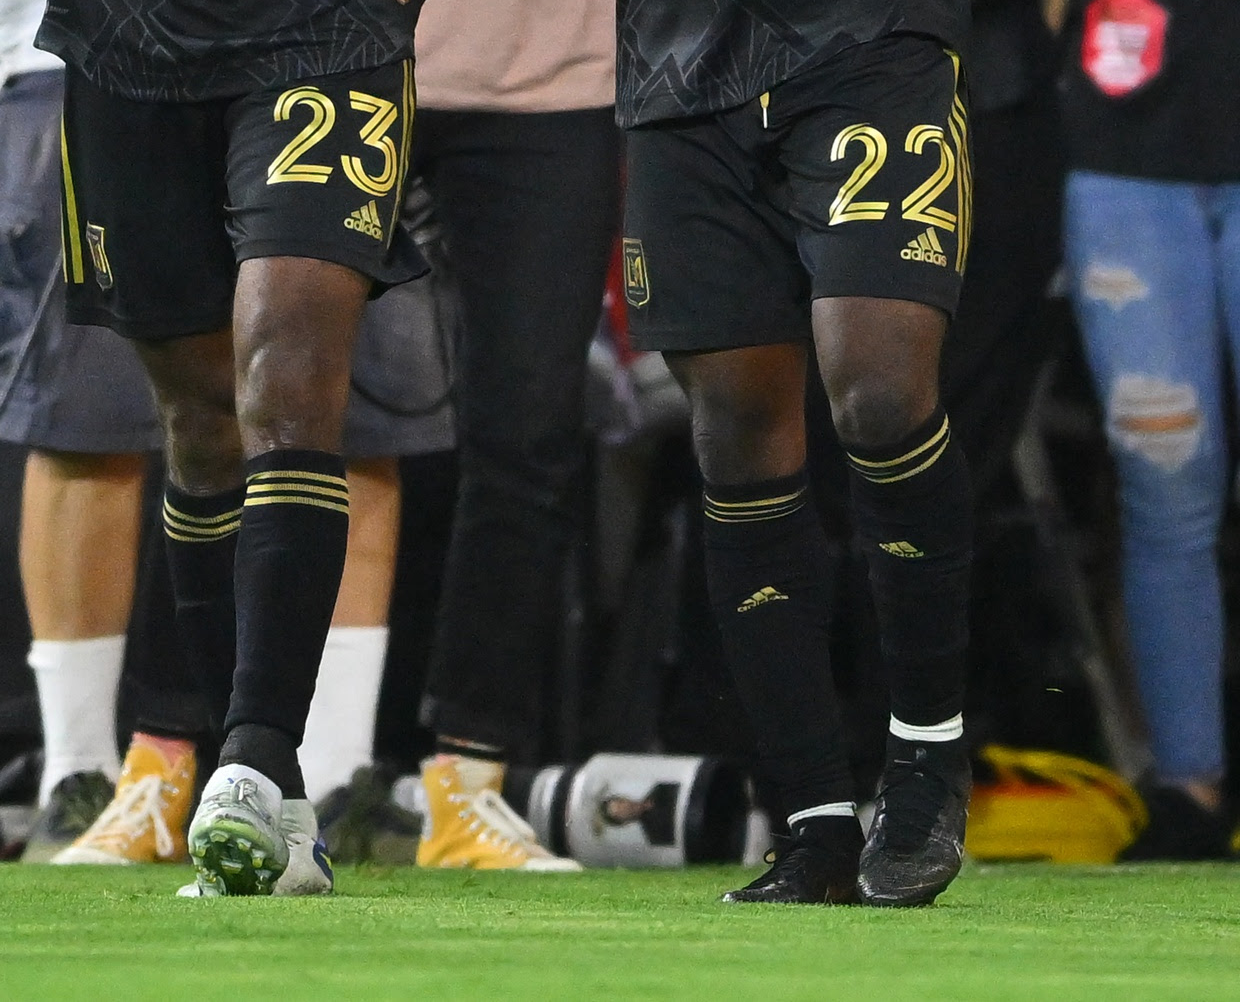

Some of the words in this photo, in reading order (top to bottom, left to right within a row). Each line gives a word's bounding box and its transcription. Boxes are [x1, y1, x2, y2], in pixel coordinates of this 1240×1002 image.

[266, 85, 398, 197] 23
[828, 122, 957, 233] 22
[900, 248, 947, 268] adidas
